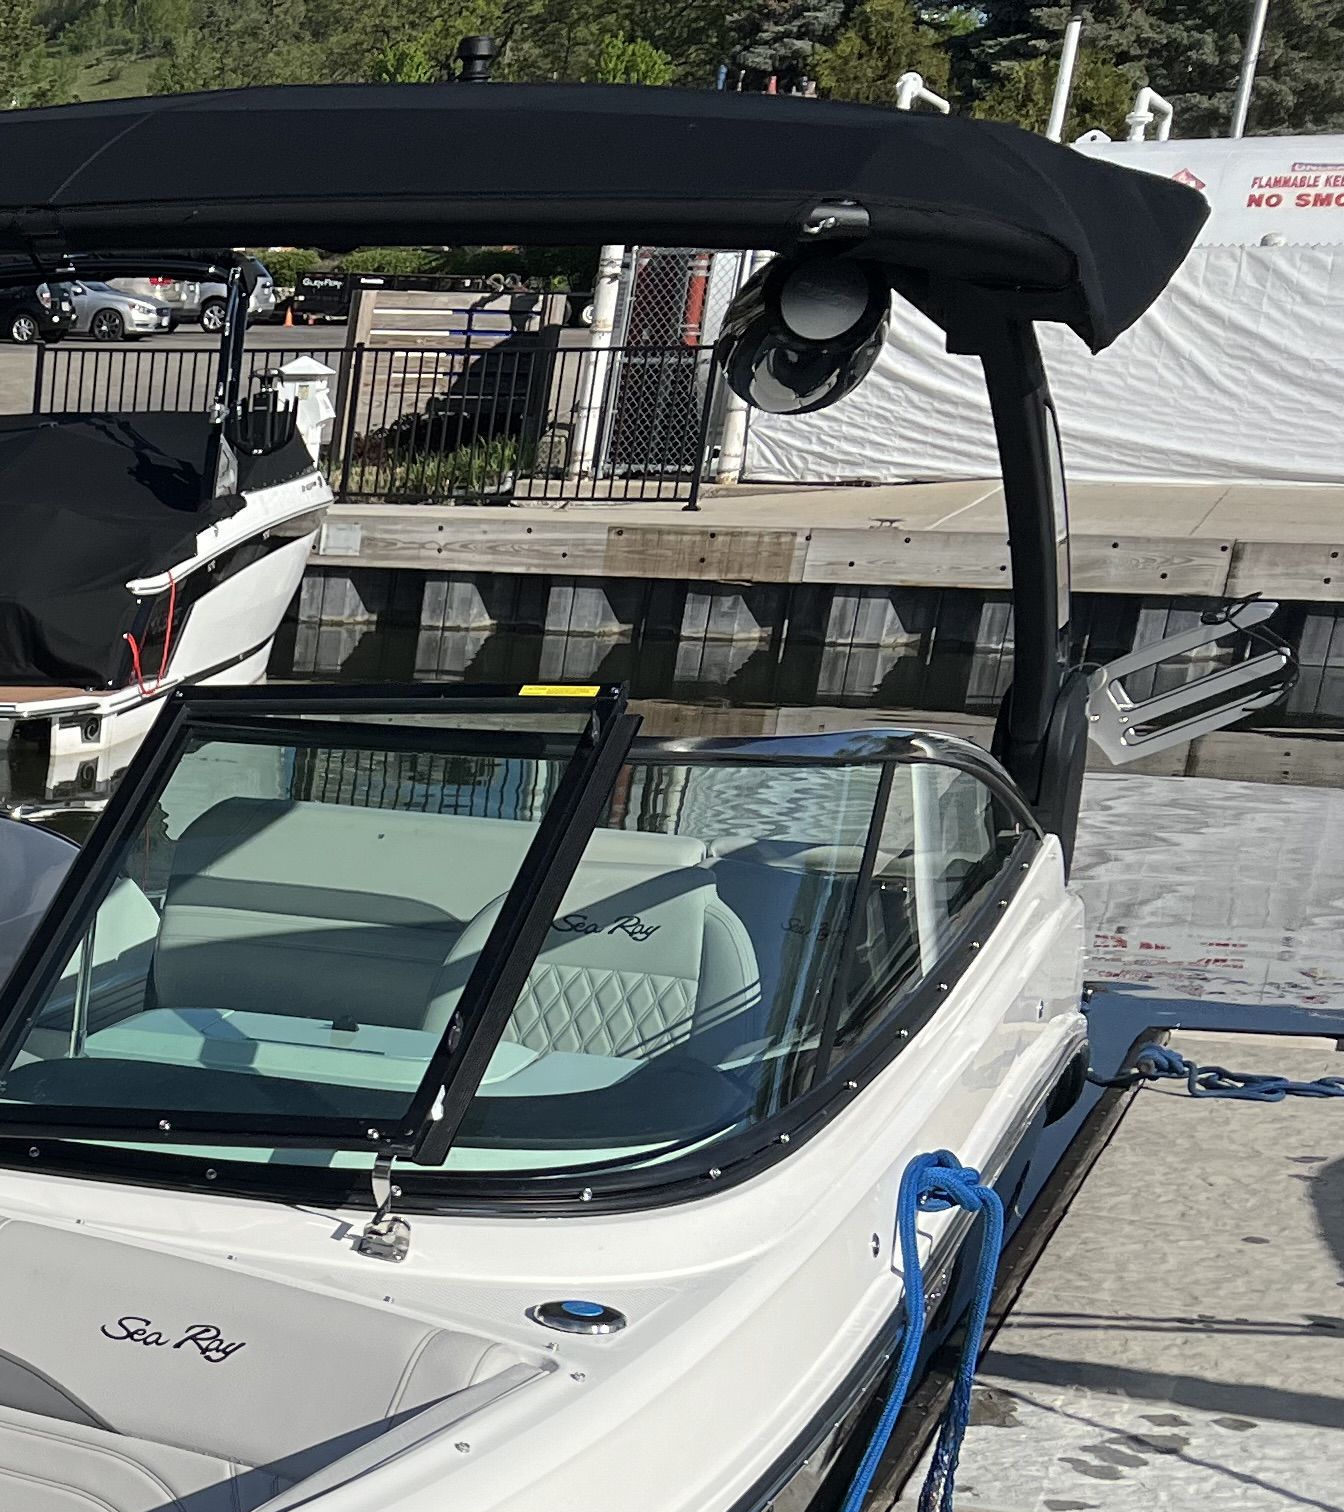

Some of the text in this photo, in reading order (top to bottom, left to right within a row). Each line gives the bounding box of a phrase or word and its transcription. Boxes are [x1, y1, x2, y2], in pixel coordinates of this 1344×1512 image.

[1251, 176, 1321, 189] FLAMMABLE
[1247, 194, 1283, 208] NO
[552, 914, 662, 942] Sea Ray
[100, 1316, 247, 1363] Sea Ray
